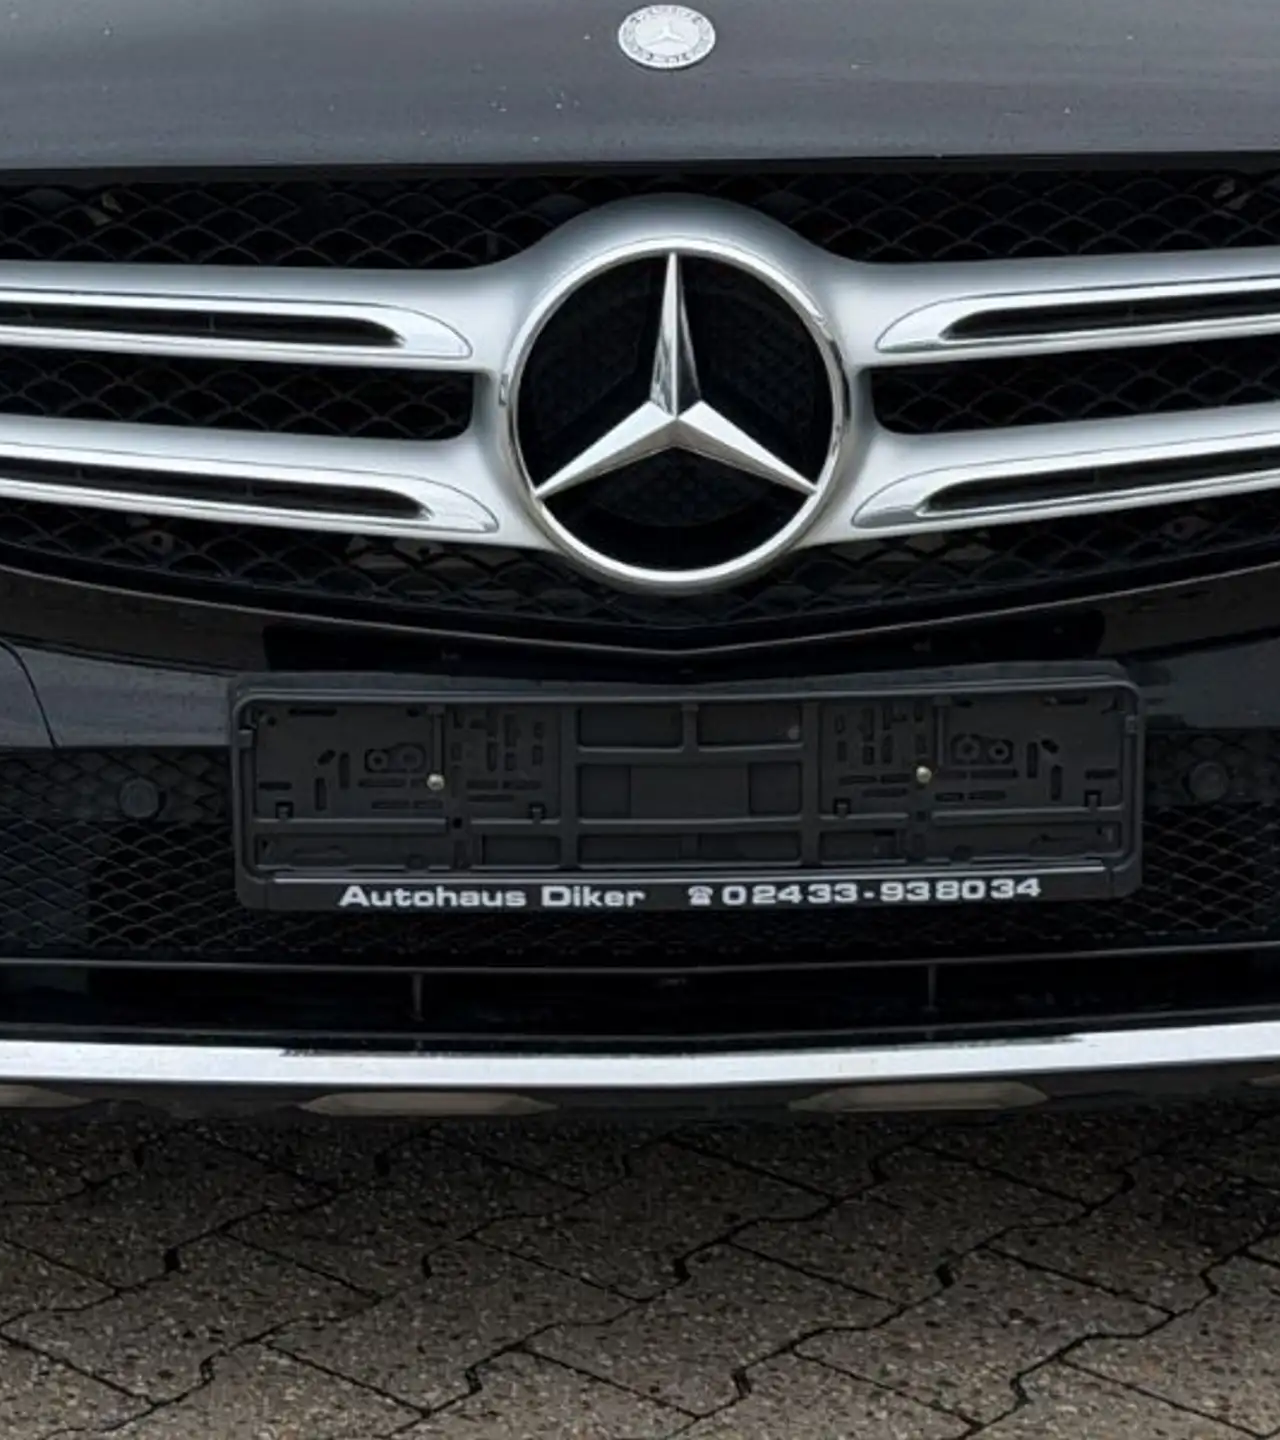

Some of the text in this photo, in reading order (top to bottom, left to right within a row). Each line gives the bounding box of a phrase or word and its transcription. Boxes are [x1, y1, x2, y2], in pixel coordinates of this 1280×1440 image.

[338, 877, 1042, 908] Autohaus Diker 02433-938034
